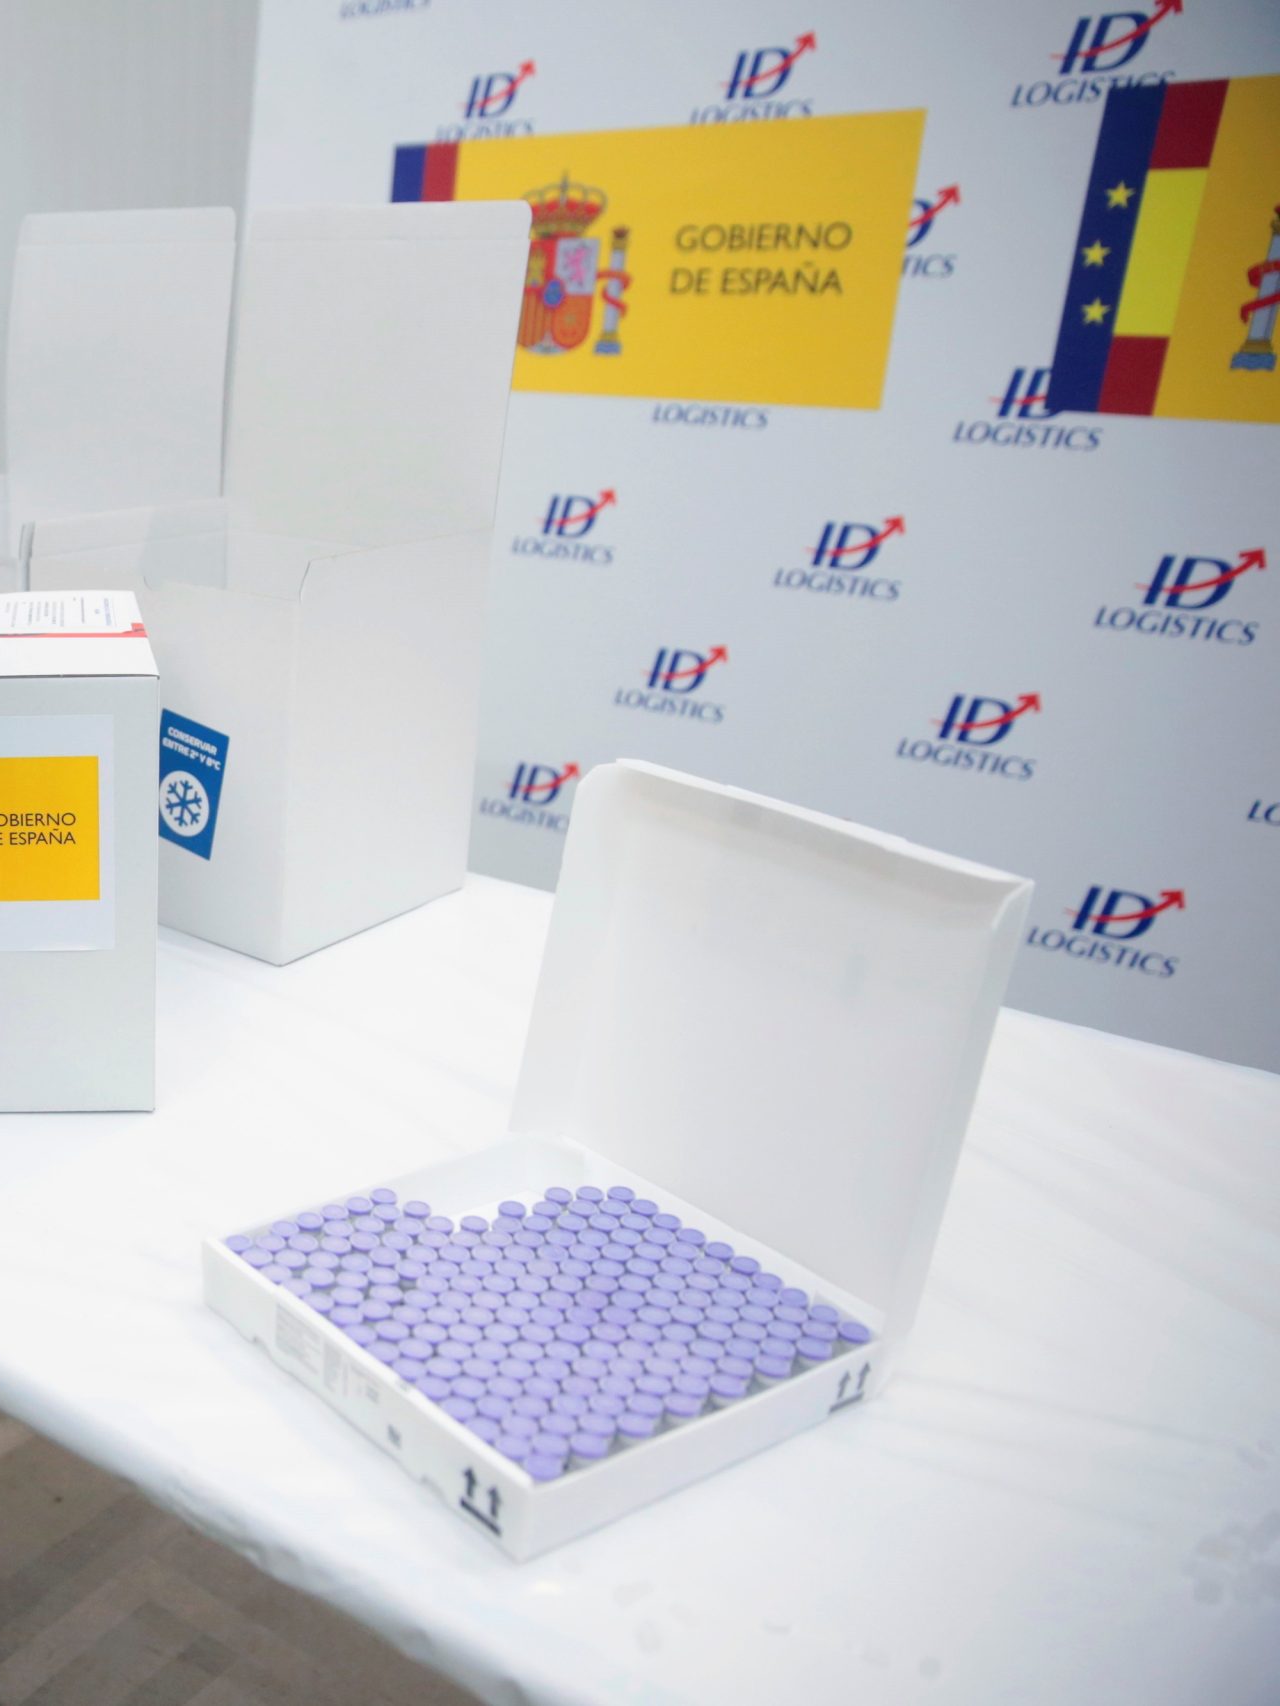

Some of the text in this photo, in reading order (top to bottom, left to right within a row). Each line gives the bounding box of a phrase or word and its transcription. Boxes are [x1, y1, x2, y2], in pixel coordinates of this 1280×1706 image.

[1059, 11, 1151, 75] ID
[464, 72, 519, 119] ID
[725, 47, 792, 101] ID
[675, 221, 853, 252] GOBIERNO
[669, 260, 844, 296] DE ESPAÑA
[651, 404, 769, 430] LOGISTICS
[952, 419, 1104, 451] LOGISTICS
[542, 494, 598, 537] ID
[511, 536, 616, 565] LOGISTICS
[813, 521, 882, 571] ID
[773, 567, 903, 601] LOGISTICS
[1143, 554, 1236, 611] ID
[1093, 605, 1261, 646] LOGISTICS
[648, 647, 707, 694] ID
[613, 687, 726, 724] LOGISTICS
[939, 694, 1014, 746] ID
[896, 738, 1038, 781] LOGISTICS
[509, 762, 562, 805] ID
[9, 828, 77, 846] ESPAÑA
[1073, 885, 1158, 940] ID
[1026, 926, 1181, 979] LOGISTICS
